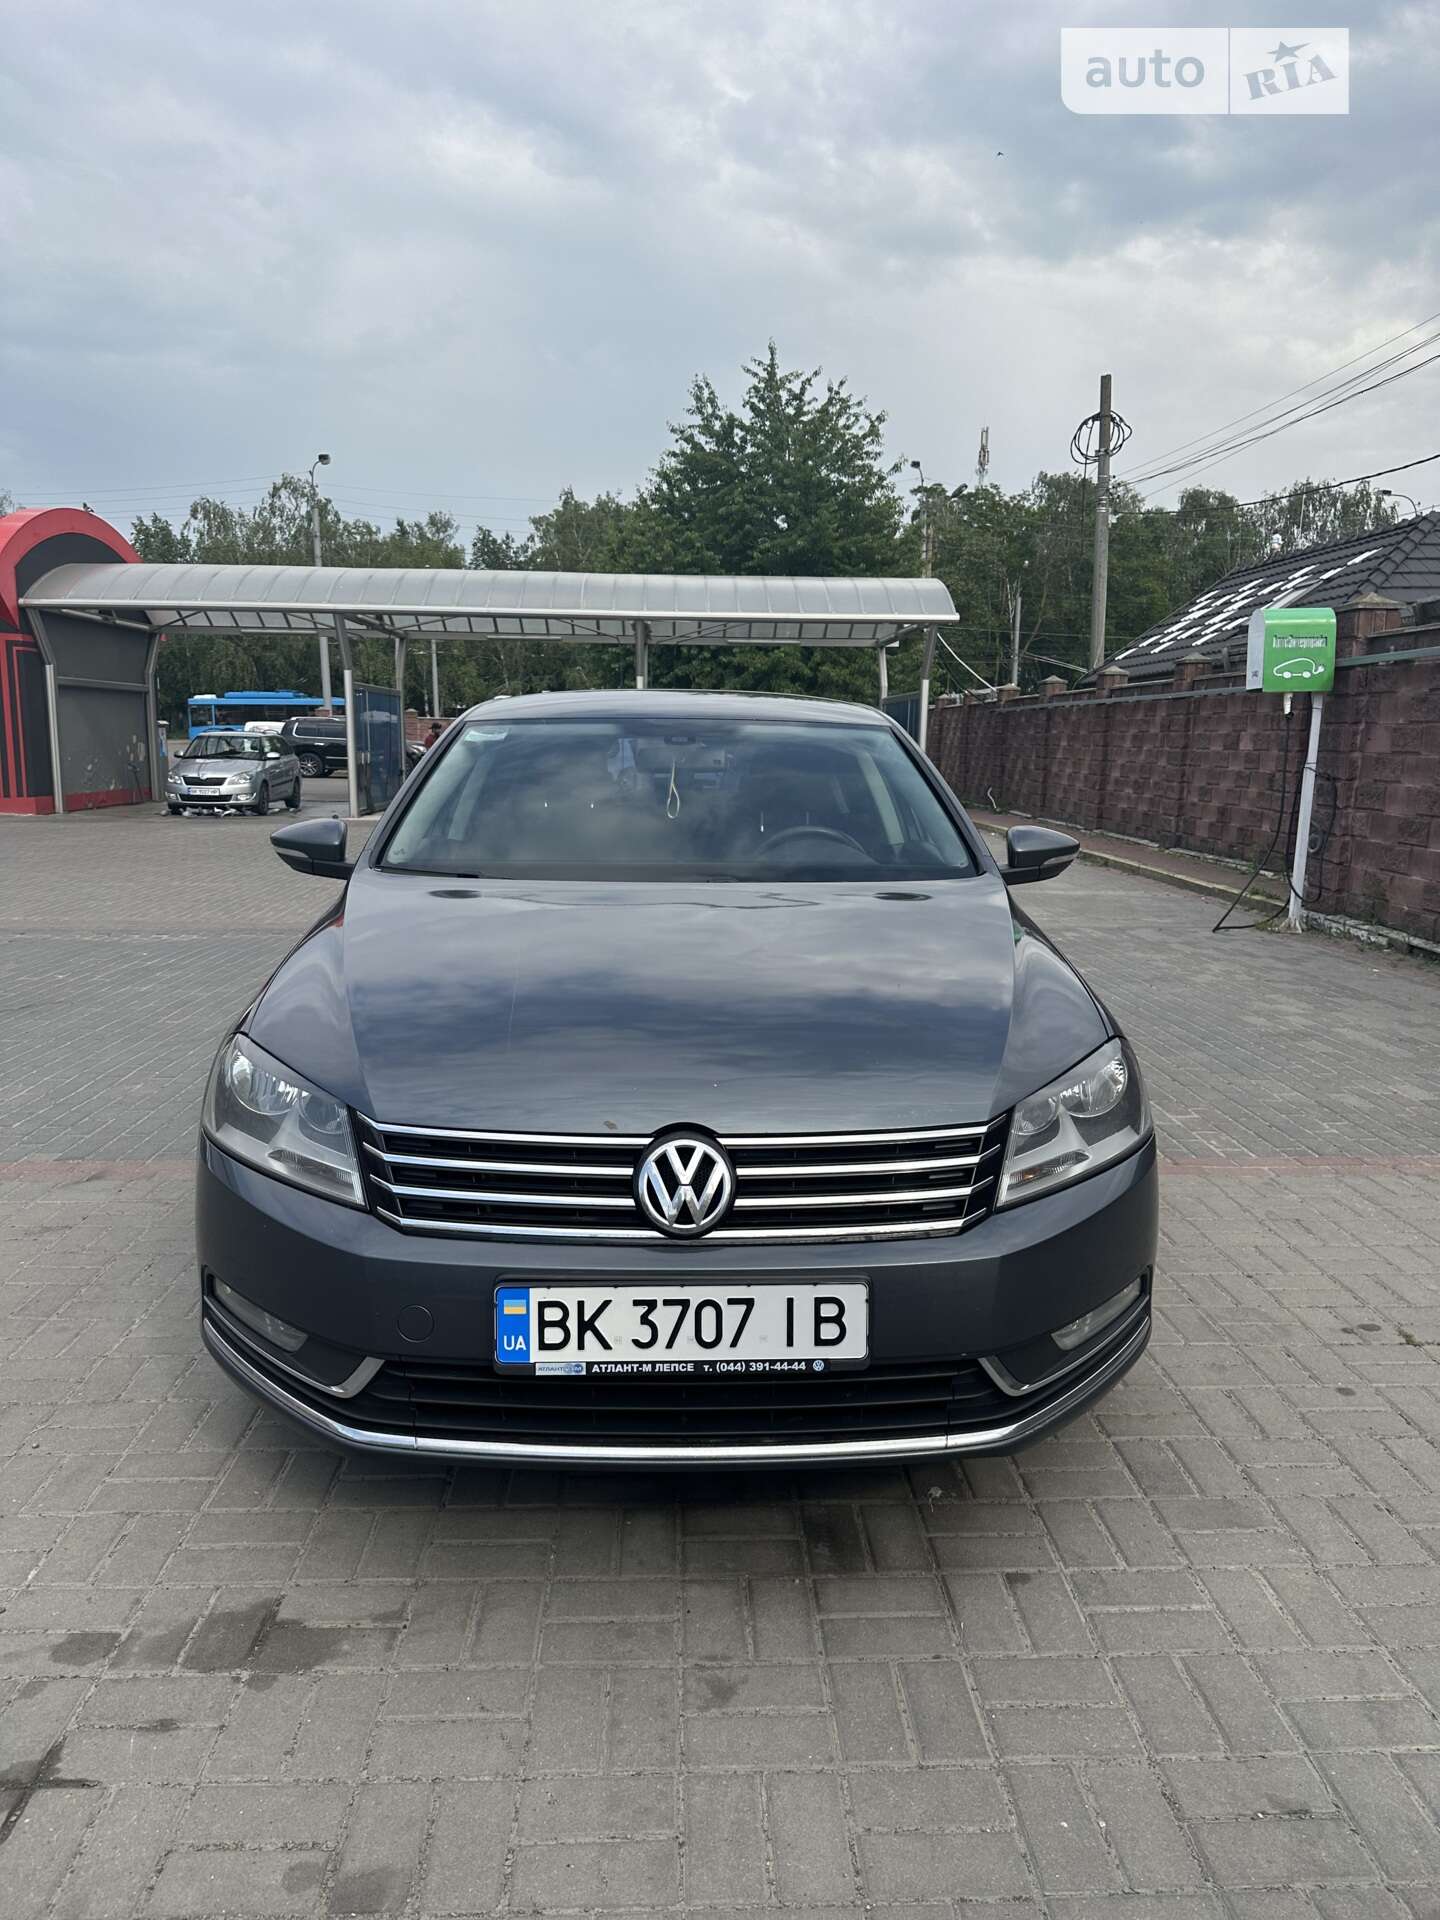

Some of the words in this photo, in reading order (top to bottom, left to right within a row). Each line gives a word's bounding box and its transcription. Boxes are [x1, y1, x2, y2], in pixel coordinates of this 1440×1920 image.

[537, 1299, 613, 1351] BK
[631, 1298, 755, 1350] 3707
[786, 1296, 847, 1347] IB
[504, 1335, 527, 1351] UA
[591, 1363, 652, 1373] АТЛАНТ-М
[655, 1362, 694, 1373] ЛЕПСЕ
[716, 1361, 746, 1373] (044)
[749, 1361, 806, 1371] 391-44-44
